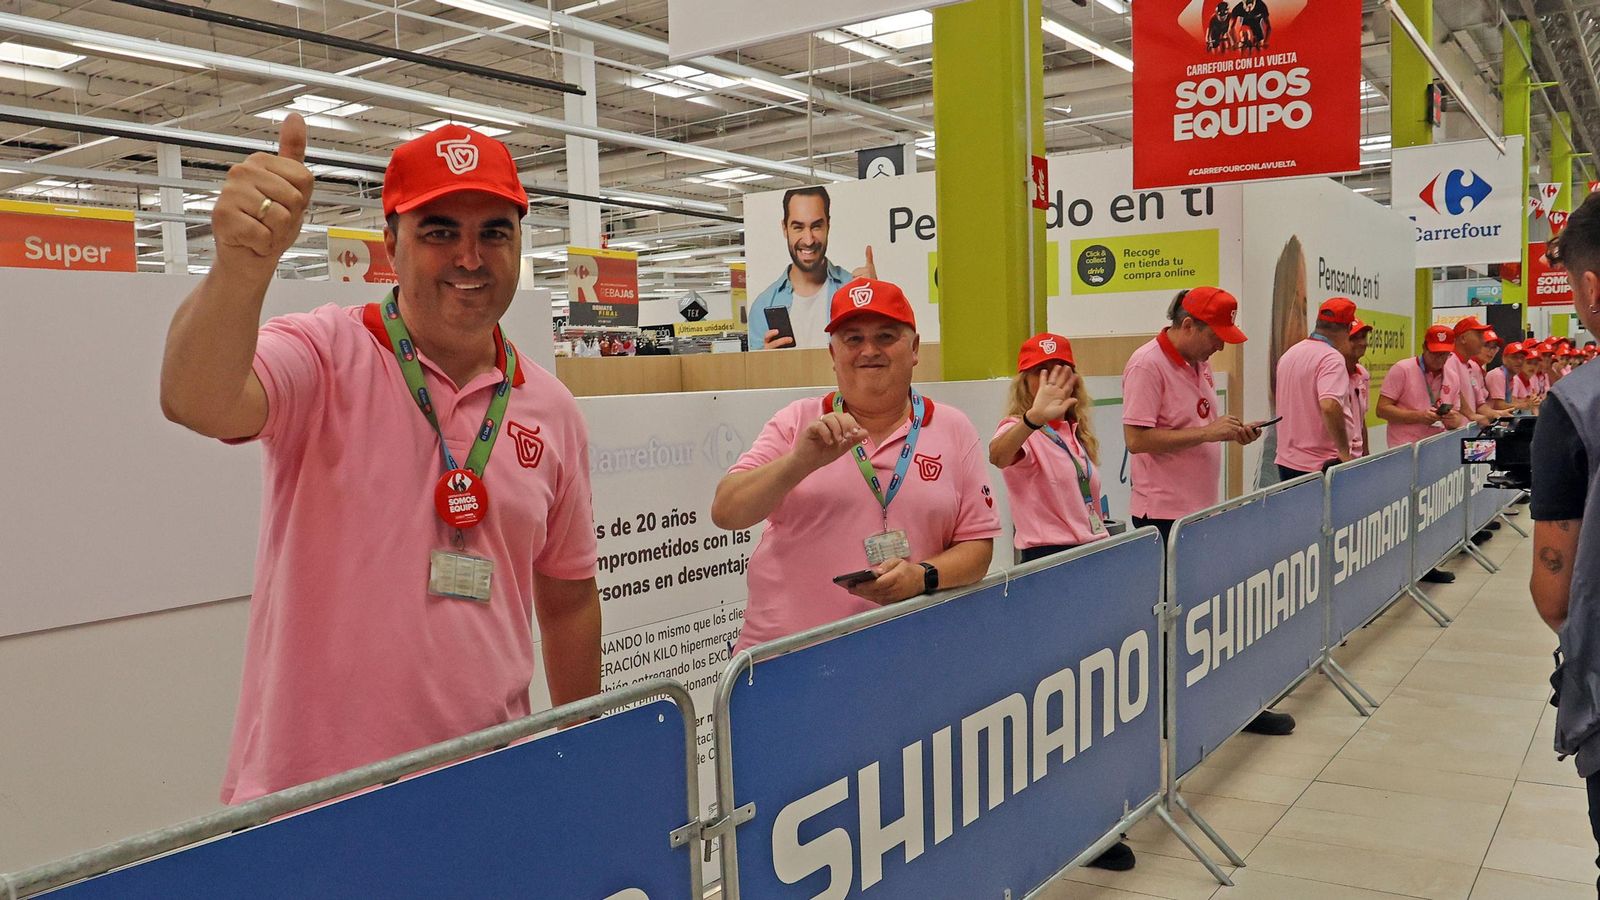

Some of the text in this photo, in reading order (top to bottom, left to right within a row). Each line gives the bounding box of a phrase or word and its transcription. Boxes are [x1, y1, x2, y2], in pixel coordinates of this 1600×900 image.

[1187, 51, 1297, 76] CARREFOUR CON LA VUELTA
[1175, 67, 1311, 109] SOMOS
[1173, 100, 1312, 141] EQUIPO
[1188, 159, 1296, 176] #CARREFOURCONLAVUELTA
[1110, 191, 1164, 223] en
[25, 235, 112, 267] Super
[1123, 248, 1161, 258] Recoge
[1138, 257, 1170, 268] tienda
[1173, 257, 1184, 265] tu
[1087, 267, 1105, 275] drive
[1123, 268, 1196, 280] compra online
[1318, 256, 1380, 299] Pensando en ti
[1537, 276, 1569, 286] SOM
[1536, 285, 1574, 294] EQUIP
[687, 309, 700, 317] TEX
[1384, 330, 1399, 355] para
[1400, 324, 1405, 349] ti
[448, 495, 477, 505] SOMOS
[449, 503, 479, 513] EQUIPO
[1418, 466, 1465, 532] SHIMANO
[610, 517, 632, 537] de
[636, 512, 657, 533] 20
[661, 508, 697, 529] años
[597, 529, 751, 573] mprometidos con las
[1334, 496, 1409, 585] SHIMANO
[655, 574, 673, 590] en
[1185, 542, 1320, 688] SHIMANO
[601, 608, 745, 655] NANDO lo mismo que los clie
[601, 651, 650, 678] ERACIÓN
[654, 644, 678, 662] KILO
[692, 659, 706, 670] los
[772, 629, 1150, 900] SHIMANO
